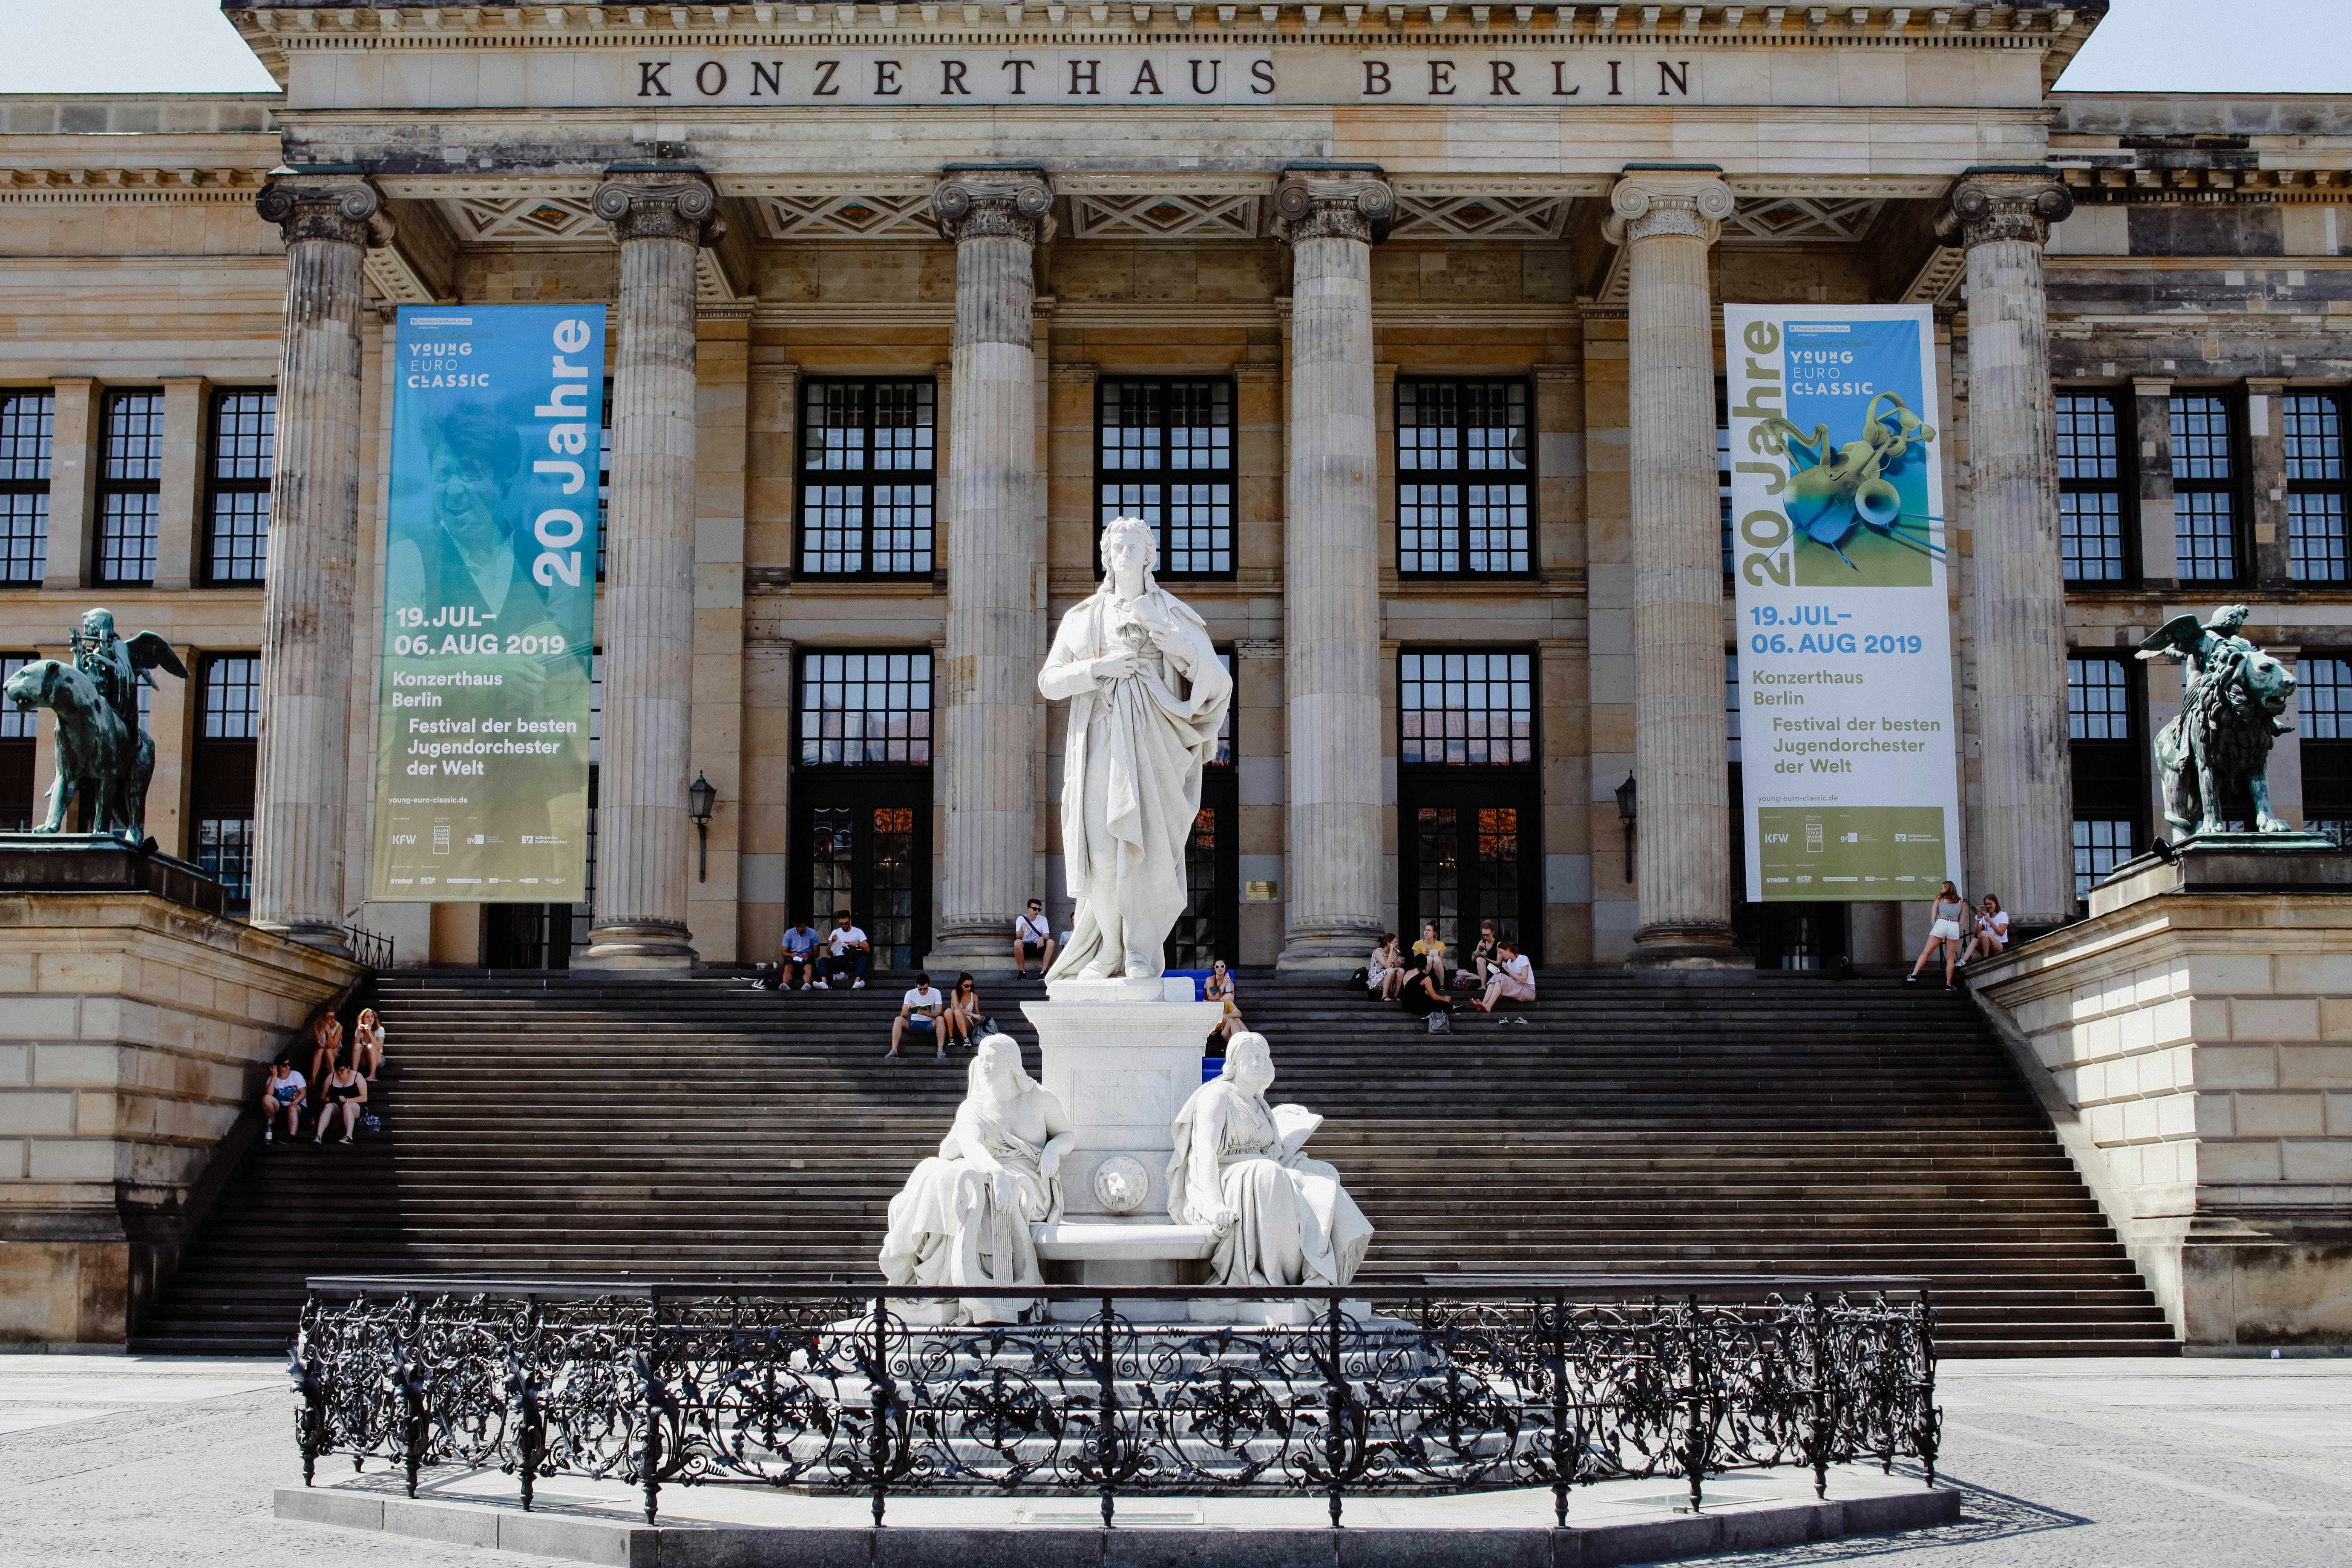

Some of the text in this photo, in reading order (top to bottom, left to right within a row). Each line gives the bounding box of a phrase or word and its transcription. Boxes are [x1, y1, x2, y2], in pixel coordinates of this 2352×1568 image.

[638, 59, 1690, 96] KONZERTHAUS BERLIN
[409, 343, 472, 356] YOUNG
[1790, 351, 1853, 364] YOUNG
[411, 360, 457, 371] EURO
[1794, 367, 1840, 379] EURO
[408, 374, 489, 388] CLASSIC
[1792, 382, 1874, 395] CLASSIC
[533, 319, 590, 587] 20 Jahre
[1733, 321, 1791, 587] 20 Jahre
[506, 635, 565, 654] 2019
[1865, 636, 1922, 653] 2019
[393, 672, 503, 686] Konzerthaus
[1753, 670, 1863, 685] Konzerthaus
[392, 693, 442, 707] Berlin
[1753, 691, 1804, 705] Berlin
[410, 718, 577, 733] Festival der besten
[1773, 717, 1940, 731] Festival der besten
[408, 739, 560, 757] Jugendorchester
[1773, 738, 1925, 756] Jugendorchester
[407, 761, 484, 775] der Welt
[1774, 759, 1852, 773] der Welt
